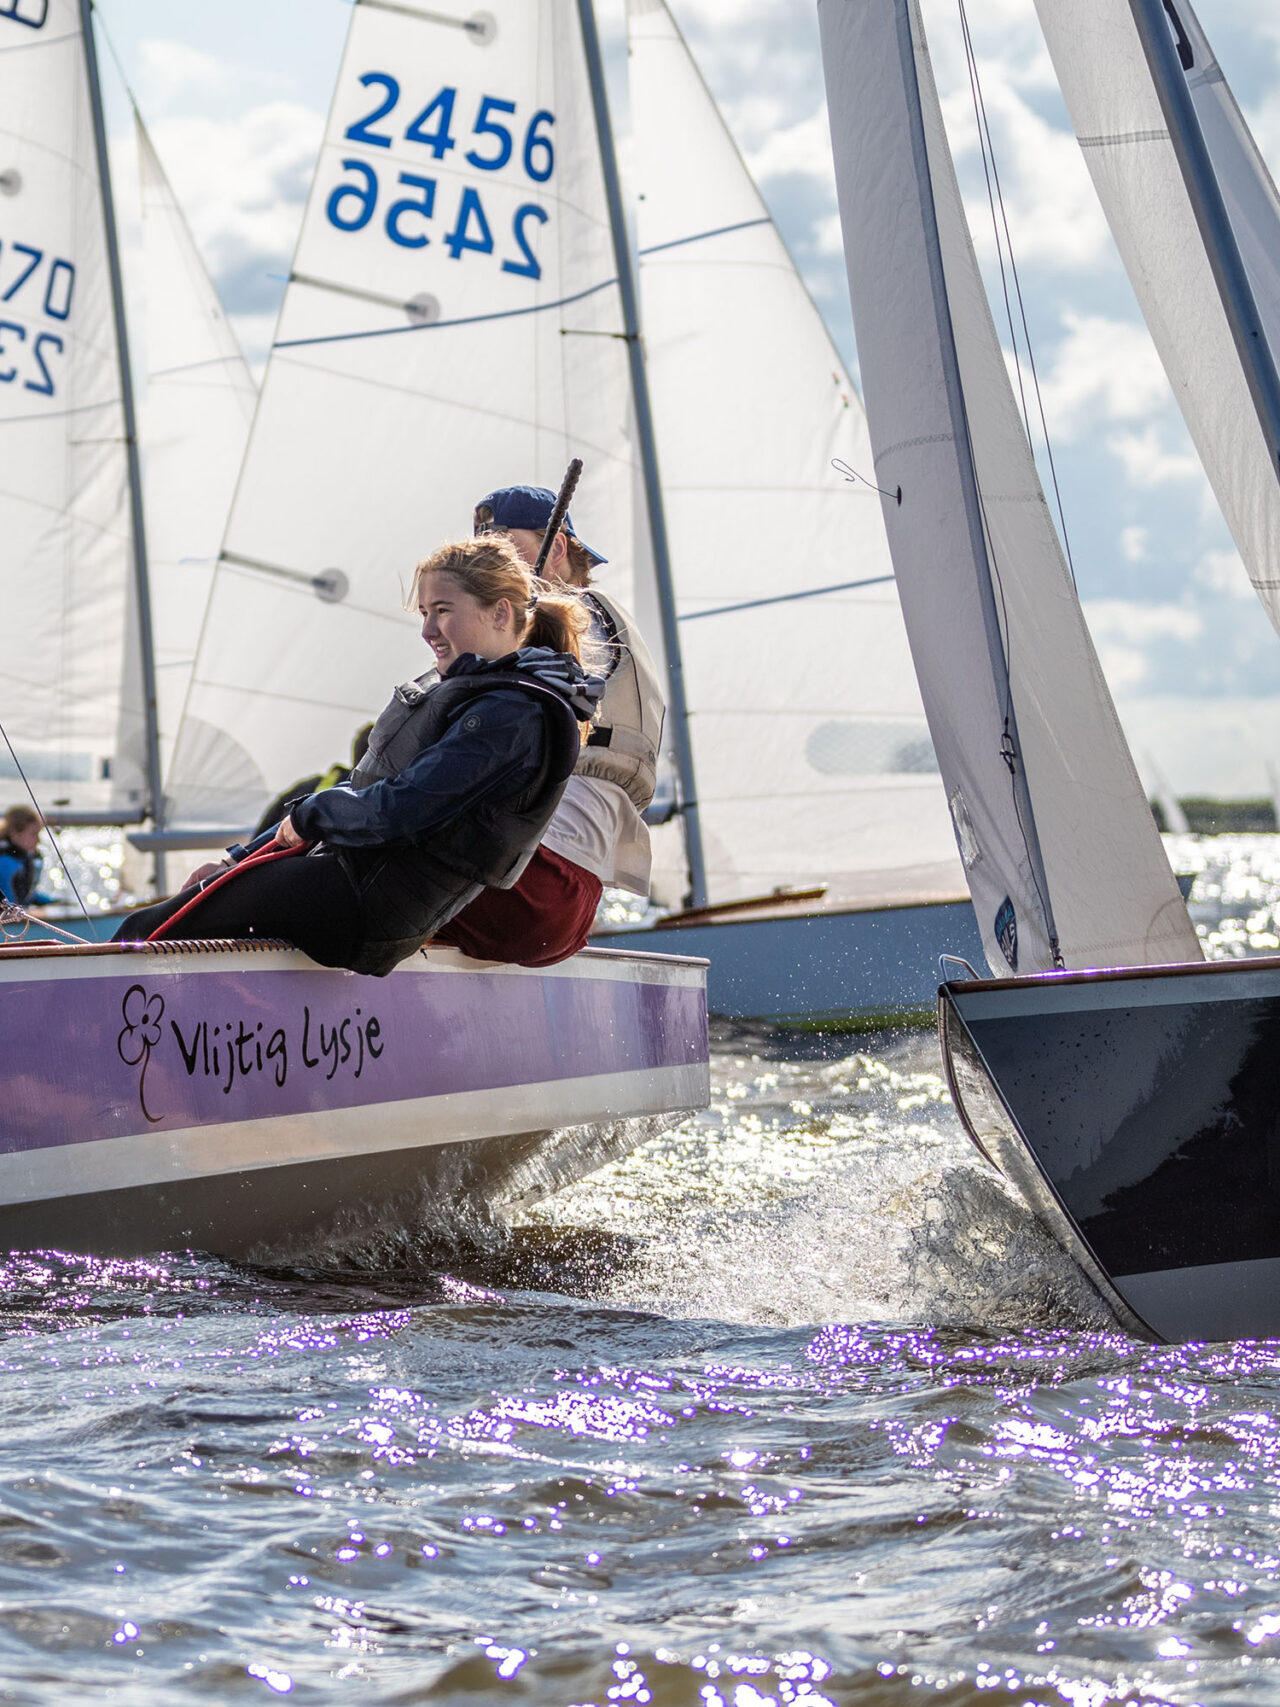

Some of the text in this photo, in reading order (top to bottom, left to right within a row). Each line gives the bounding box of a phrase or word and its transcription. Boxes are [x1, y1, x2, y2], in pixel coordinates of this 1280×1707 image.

[344, 70, 556, 183] 2456
[171, 1006, 384, 1094] Vlijtig Lysje
